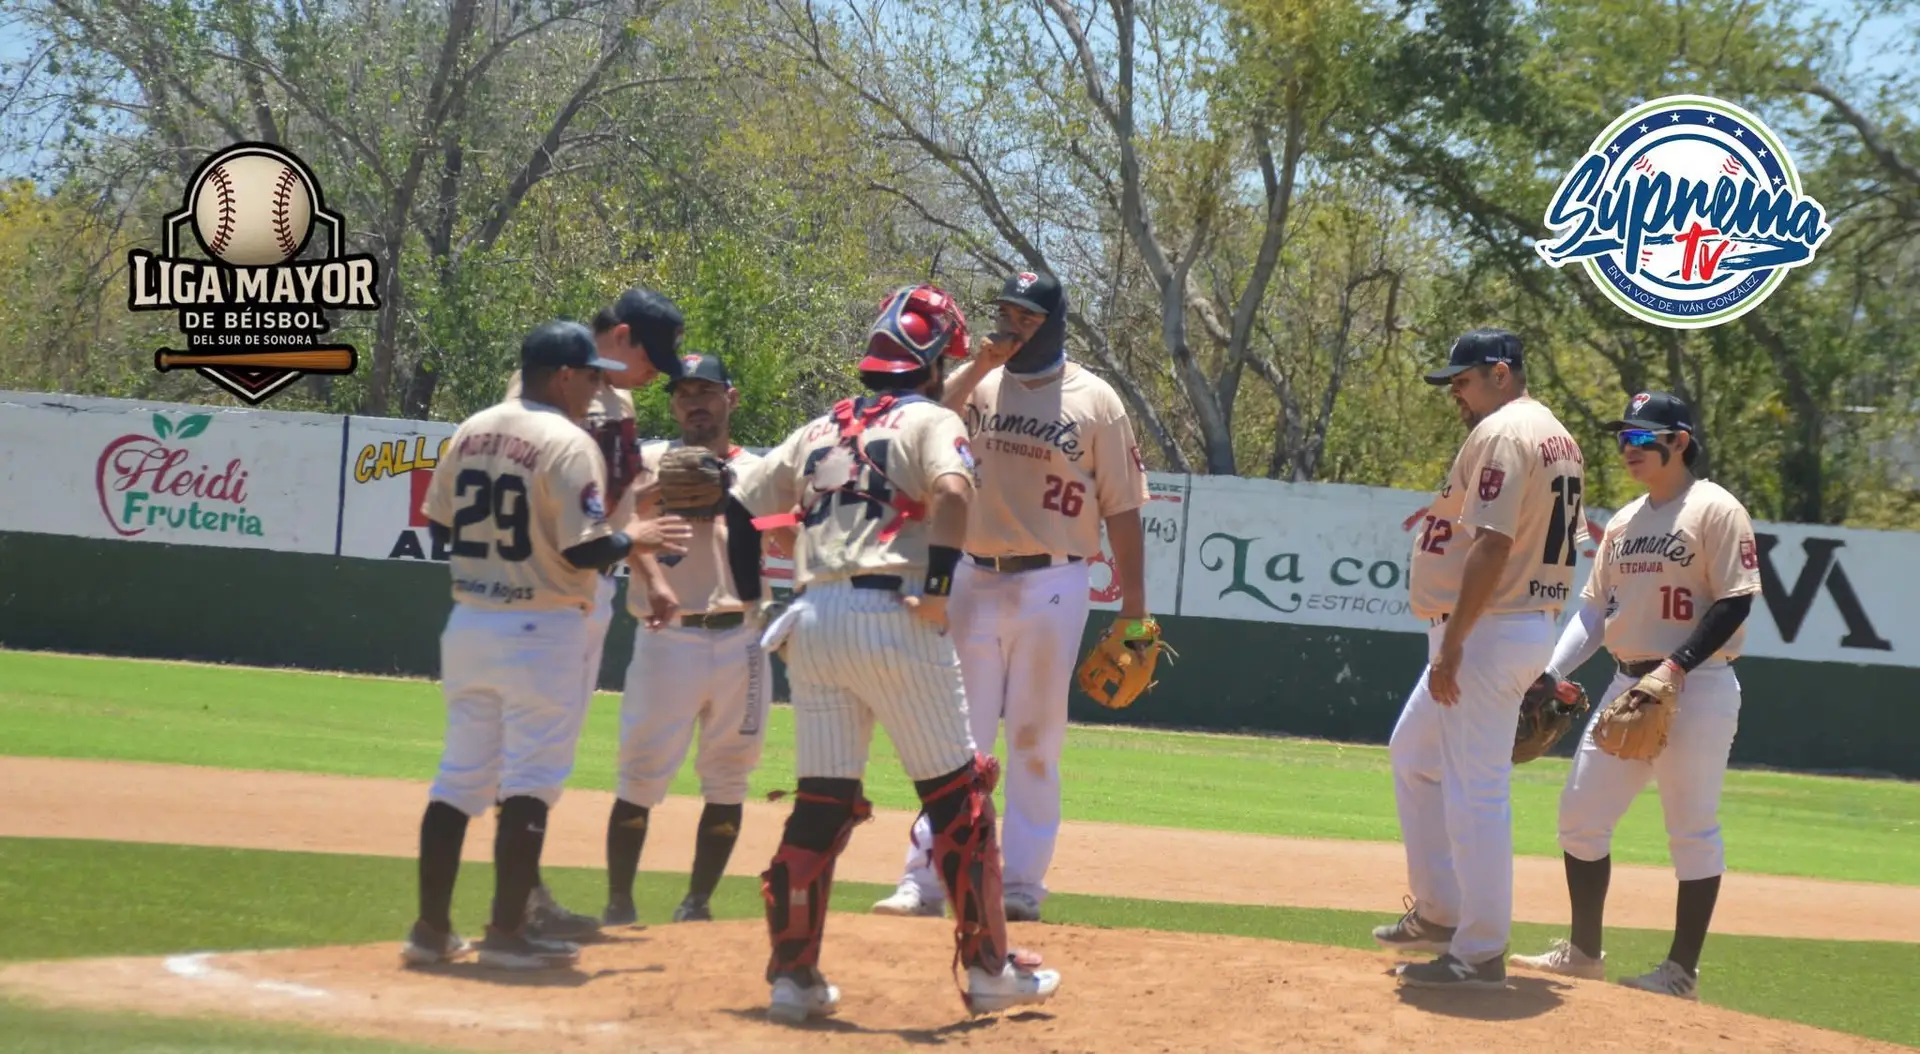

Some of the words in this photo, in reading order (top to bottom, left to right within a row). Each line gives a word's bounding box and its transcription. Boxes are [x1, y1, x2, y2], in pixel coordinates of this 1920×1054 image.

[967, 403, 1084, 462] Diamantes
[113, 447, 248, 504] Heidi
[1043, 474, 1086, 518] 26
[122, 491, 264, 536] Fruteria
[451, 468, 532, 561] 29
[1421, 515, 1452, 555] 12
[1199, 532, 1304, 613] La
[1660, 585, 1693, 621] 16
